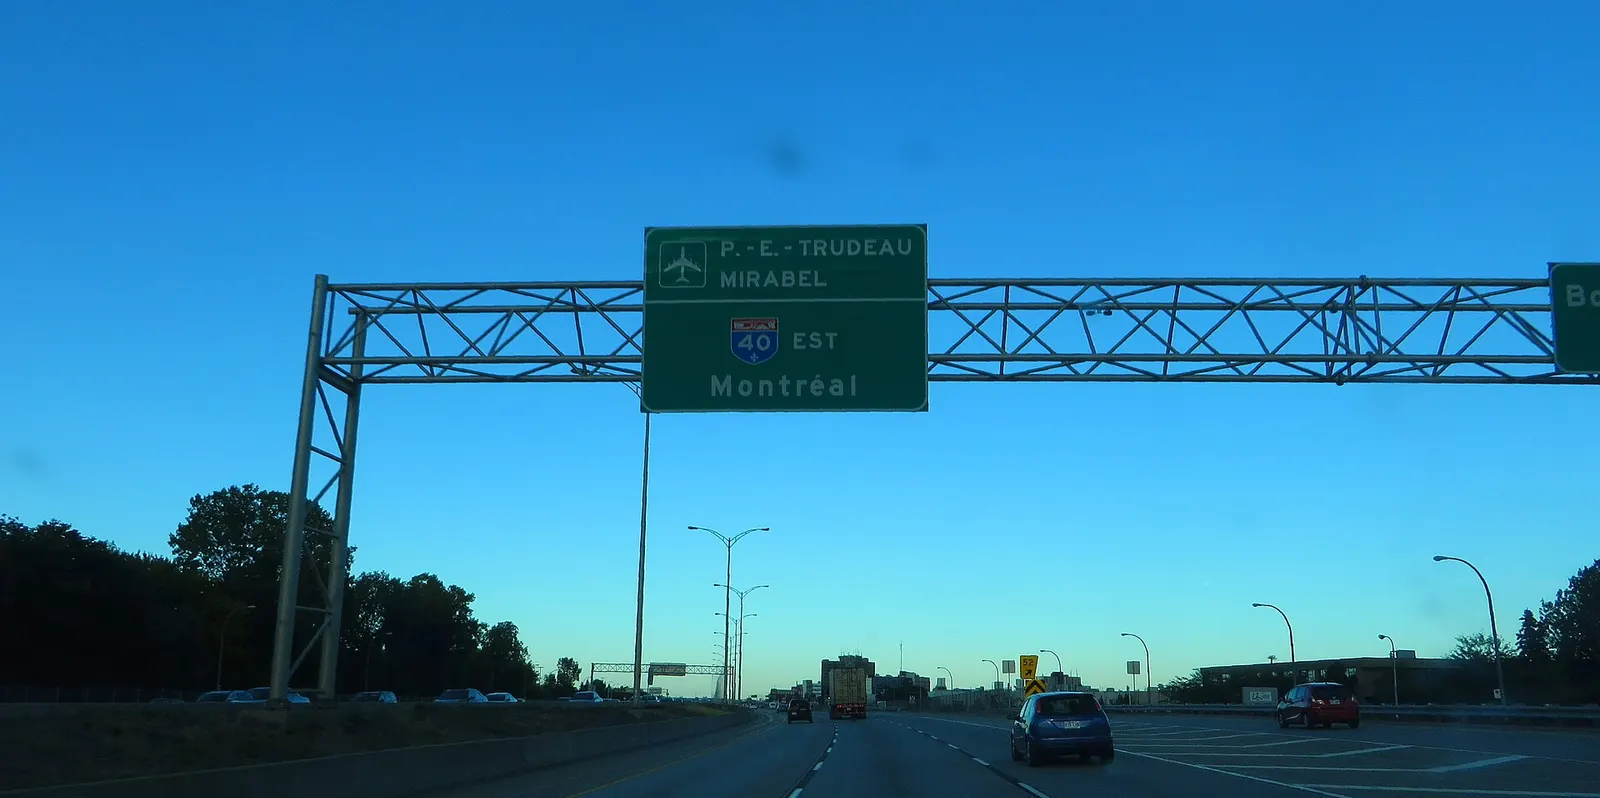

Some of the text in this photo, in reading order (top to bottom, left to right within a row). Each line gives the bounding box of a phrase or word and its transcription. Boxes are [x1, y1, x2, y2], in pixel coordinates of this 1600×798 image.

[720, 270, 827, 288] MIRABEL
[737, 332, 838, 351] 40 EST
[711, 374, 857, 397] Montréal
